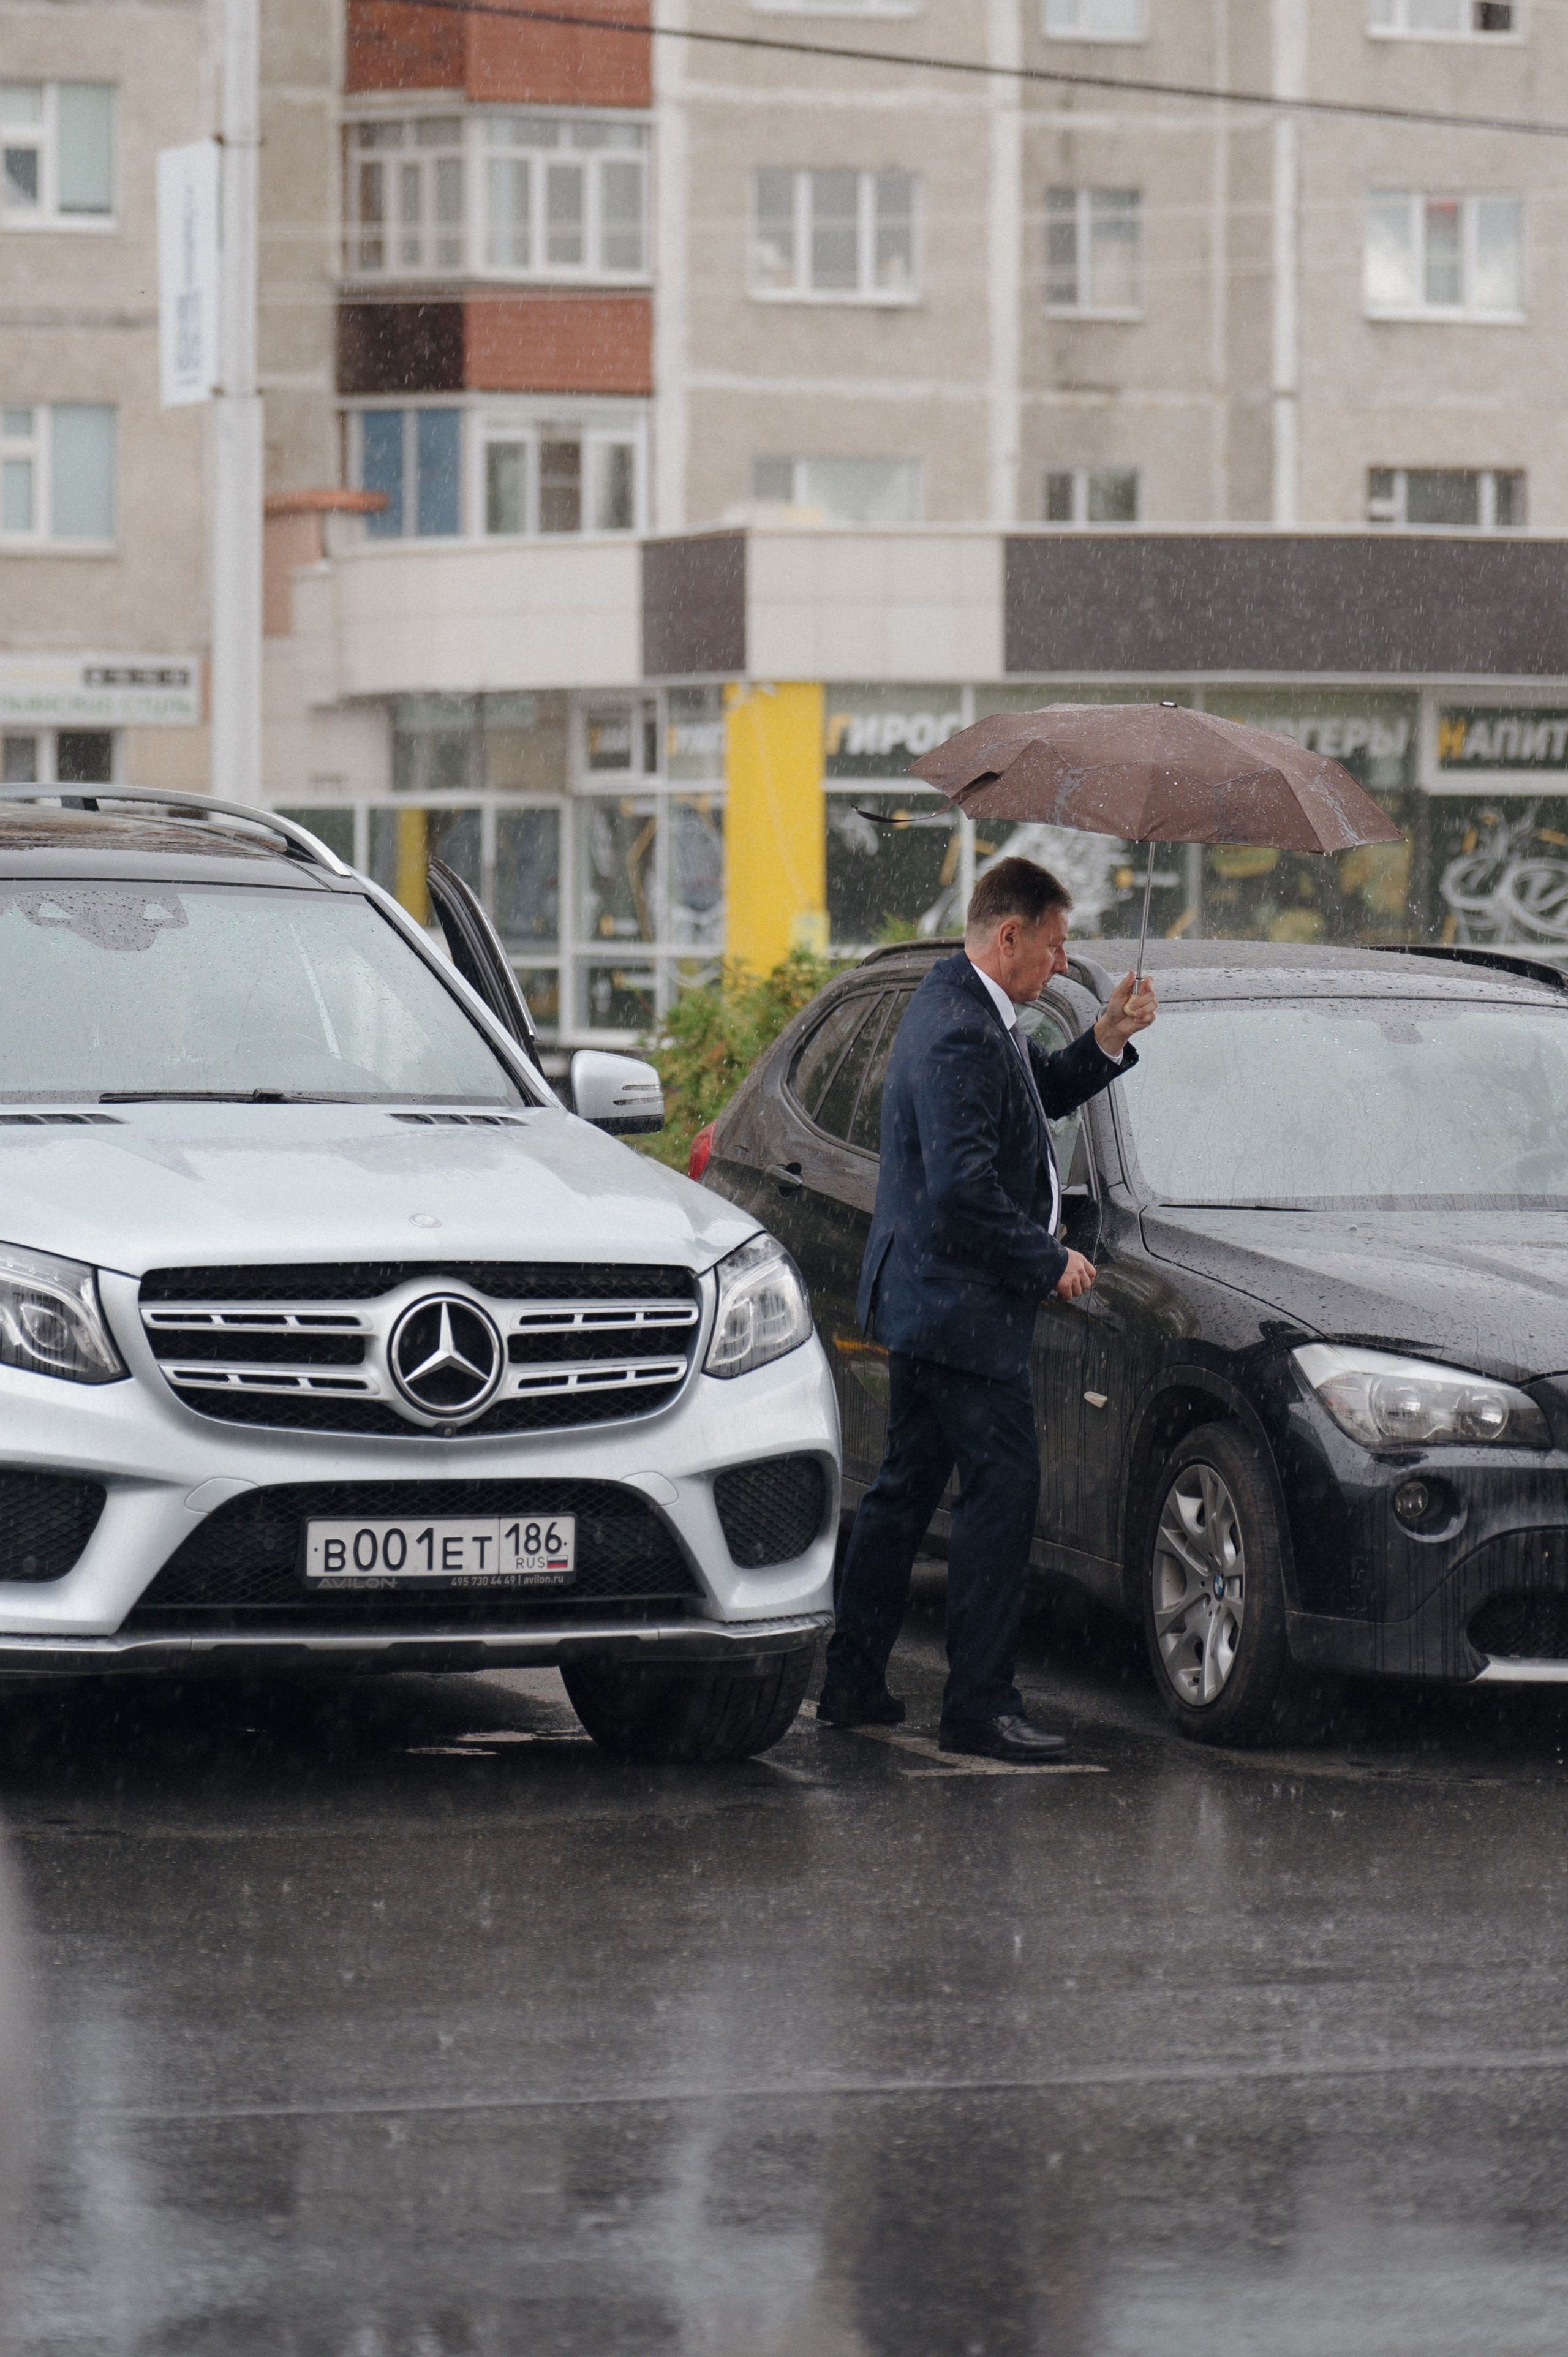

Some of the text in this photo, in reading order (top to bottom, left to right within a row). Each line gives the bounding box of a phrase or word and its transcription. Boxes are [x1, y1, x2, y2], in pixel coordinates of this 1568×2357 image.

[504, 1522, 562, 1556] 186
[516, 1557, 545, 1569] RUS
[317, 1577, 398, 1589] AVILON
[451, 1574, 564, 1586] 495 730 44 49 avilon.ru
